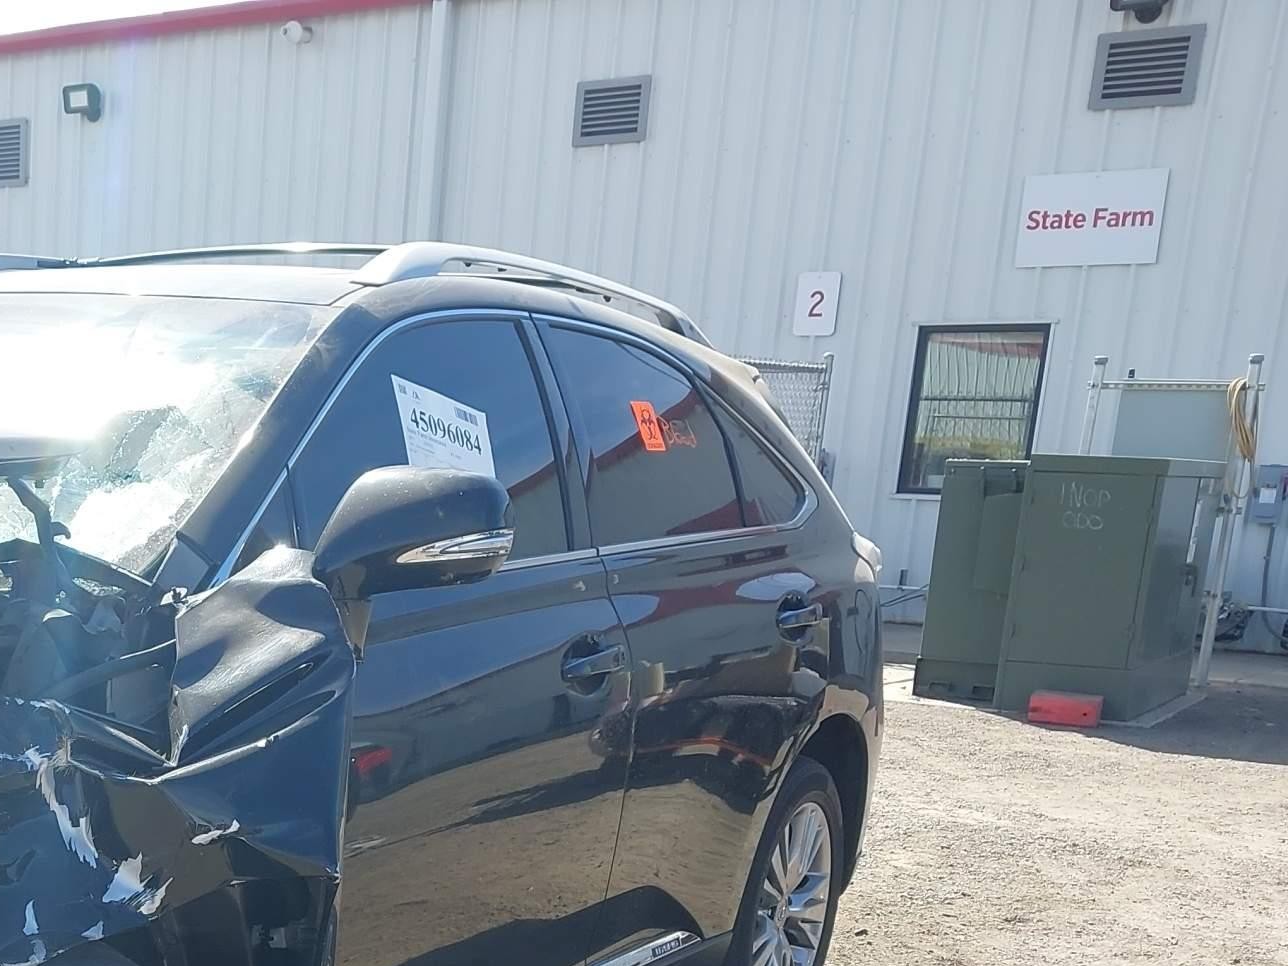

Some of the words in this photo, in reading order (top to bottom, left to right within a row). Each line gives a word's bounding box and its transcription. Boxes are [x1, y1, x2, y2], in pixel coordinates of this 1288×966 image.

[1026, 210, 1086, 230] State
[1092, 207, 1154, 228] Farm
[808, 290, 824, 317] 2
[410, 407, 482, 456] 45096084
